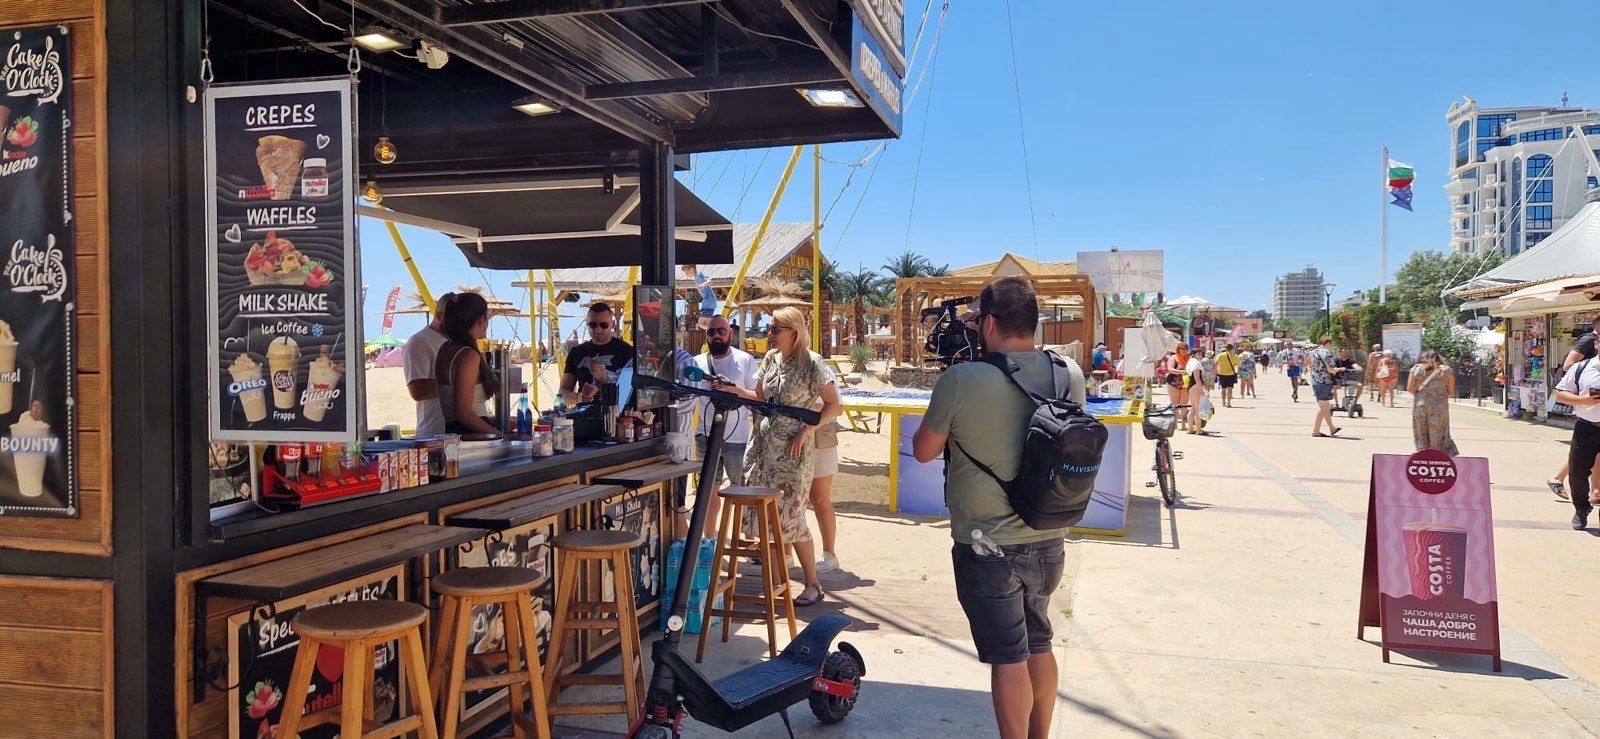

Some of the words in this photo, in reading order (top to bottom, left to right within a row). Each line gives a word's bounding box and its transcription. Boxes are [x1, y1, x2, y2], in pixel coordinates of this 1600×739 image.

[7, 43, 42, 69] Cake
[6, 67, 55, 91] O'Clock
[245, 103, 315, 126] CREPES
[239, 184, 276, 199] nutella
[246, 206, 317, 226] WAFFLES
[11, 239, 44, 267] Cake
[10, 263, 58, 288] O'Clock
[238, 293, 275, 312] MILK
[276, 293, 328, 311] SHAKE
[261, 322, 276, 335] Ice
[276, 321, 309, 335] Coffee
[228, 378, 267, 394] OREO
[300, 388, 340, 406] bueno
[273, 410, 296, 422] Frappe
[0, 436, 59, 452] BOUNTY
[1408, 465, 1456, 477] COSTA
[1428, 544, 1443, 596] COSTA
[1402, 608, 1444, 618] ЗАПОЧНИ
[1444, 612, 1469, 620] ДЕНЯ
[1469, 613, 1476, 621] С
[1402, 617, 1437, 628] ЧАША
[1438, 620, 1477, 630] ДОБРО
[1403, 627, 1477, 641] НАСТРОЕНИЕ
